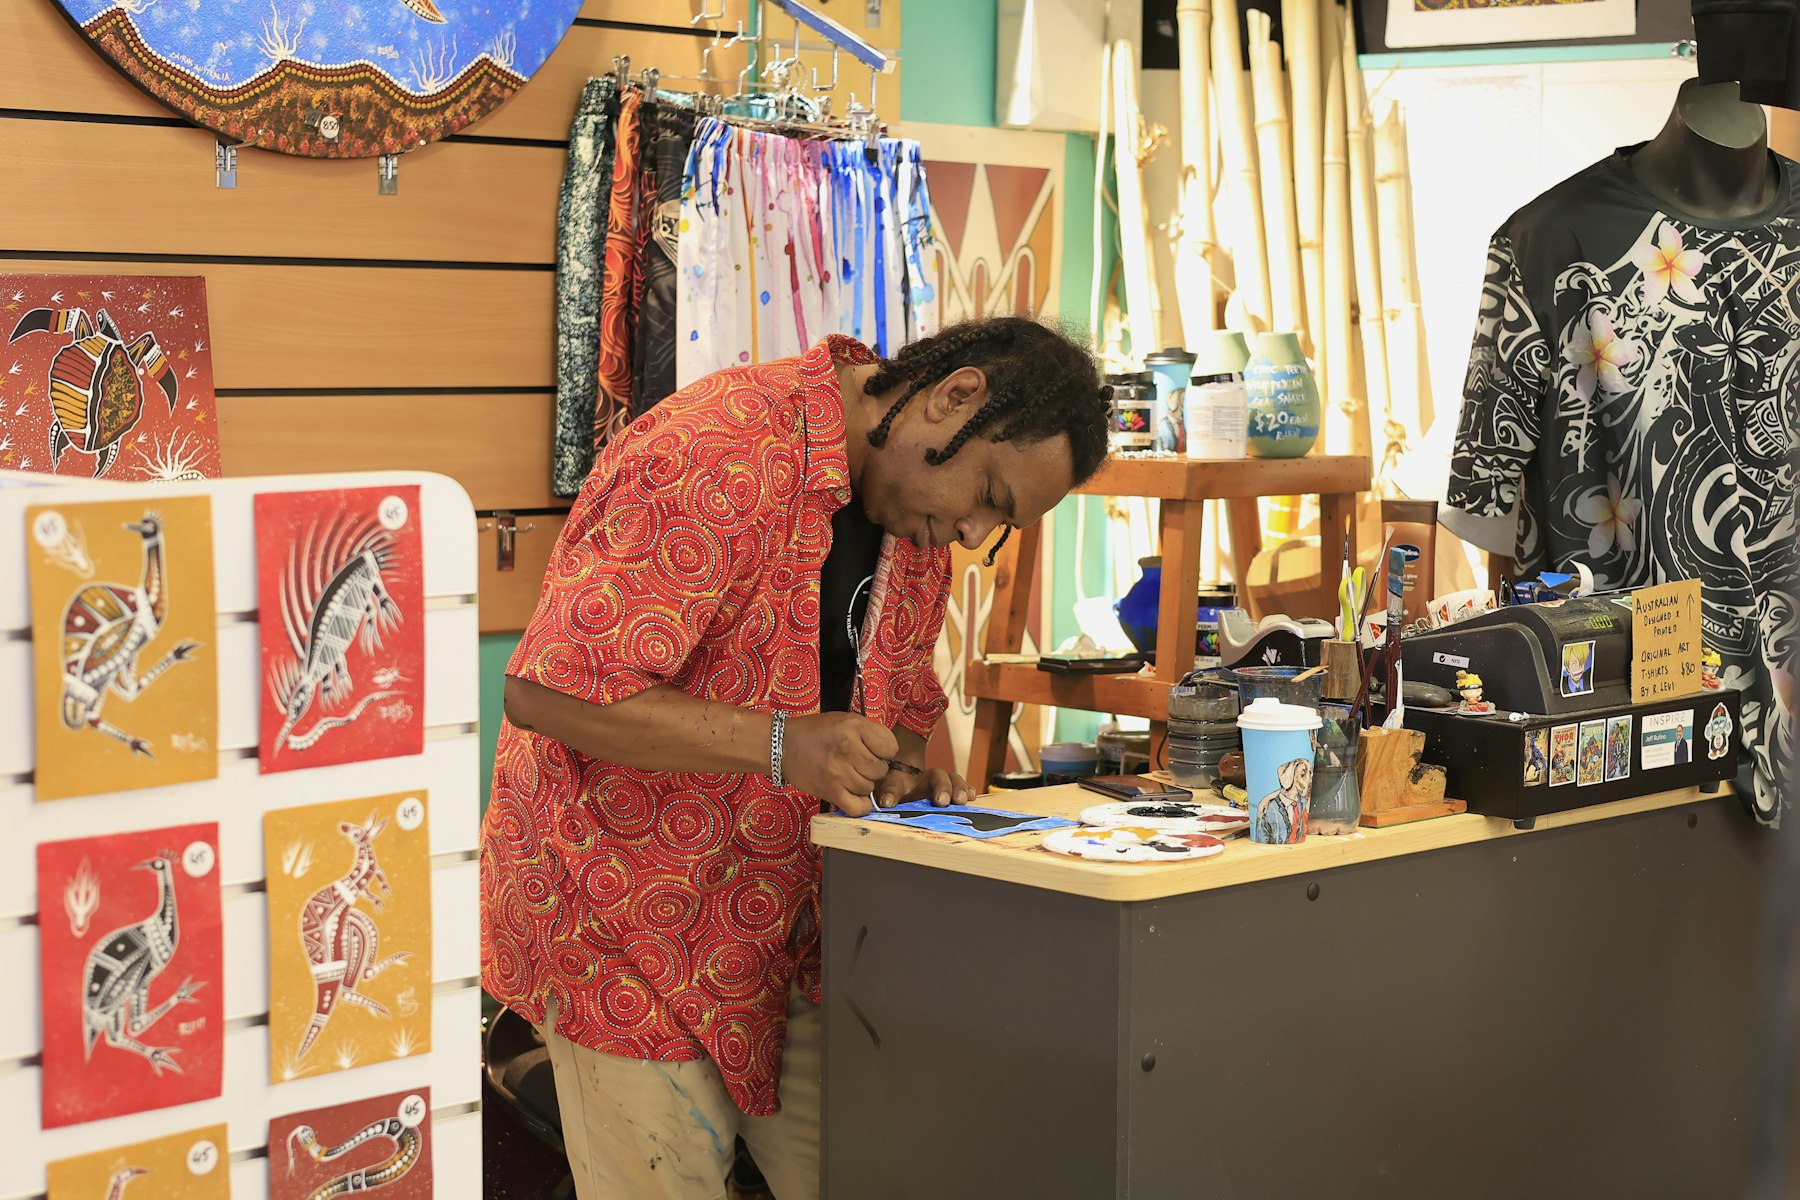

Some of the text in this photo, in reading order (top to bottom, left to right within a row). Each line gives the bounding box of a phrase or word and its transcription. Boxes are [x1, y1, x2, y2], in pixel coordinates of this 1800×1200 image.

[323, 120, 339, 131] 850
[1254, 410, 1289, 433] $20
[1635, 593, 1679, 615] AUSTRALIAN
[1643, 611, 1672, 627] DESIGNED
[1641, 642, 1690, 663] ORIGINAL ART
[1641, 661, 1696, 680] T-SHIRTS $80
[1660, 681, 1675, 692] LEVI
[1650, 712, 1686, 726] INSPIRE
[1554, 731, 1574, 742] THOR
[404, 1100, 420, 1117] 45
